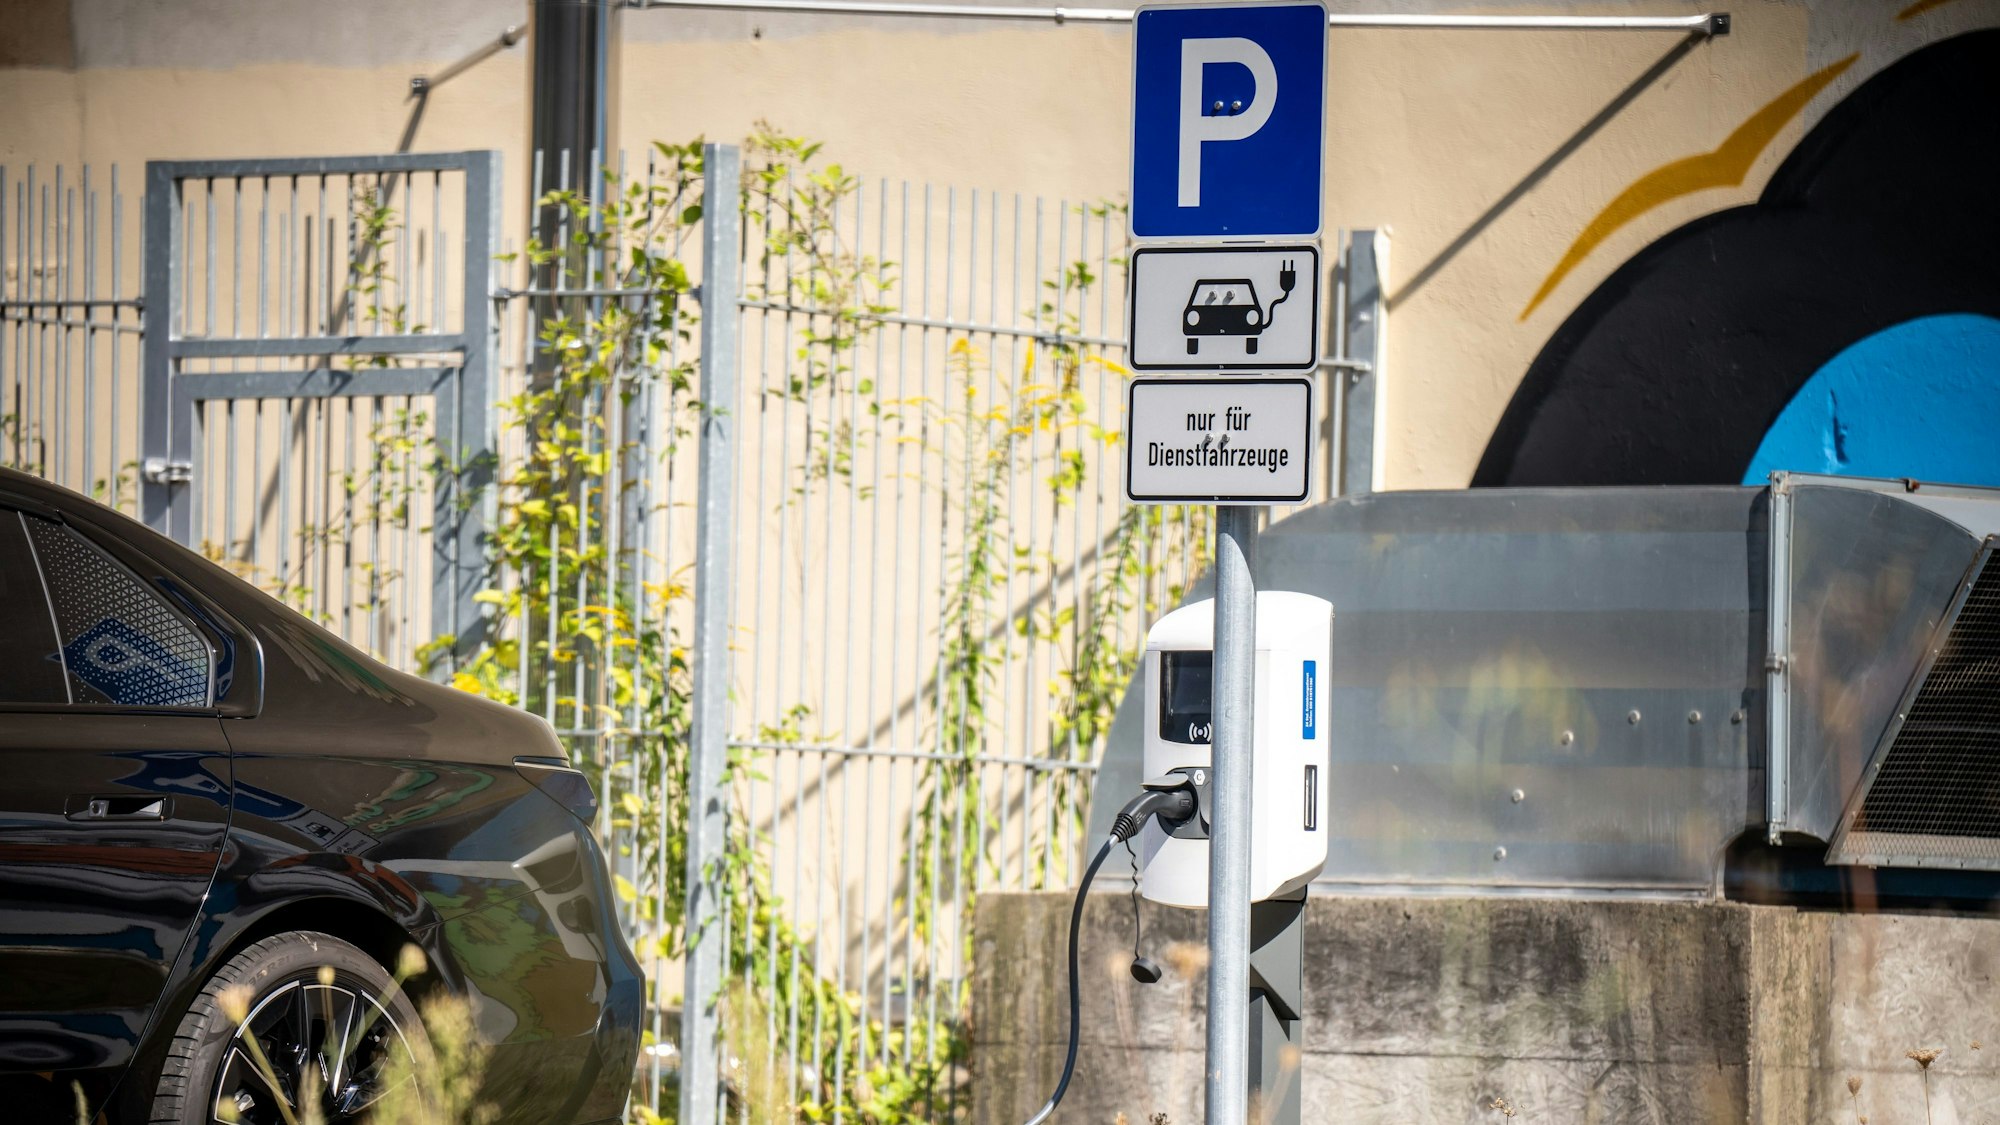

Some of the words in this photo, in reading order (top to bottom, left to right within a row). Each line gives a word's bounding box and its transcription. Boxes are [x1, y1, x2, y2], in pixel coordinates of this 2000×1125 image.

[1177, 37, 1278, 208] P
[1186, 412, 1216, 431] nur
[1225, 406, 1251, 431] für
[1148, 442, 1289, 473] Dienstfahrzeuge
